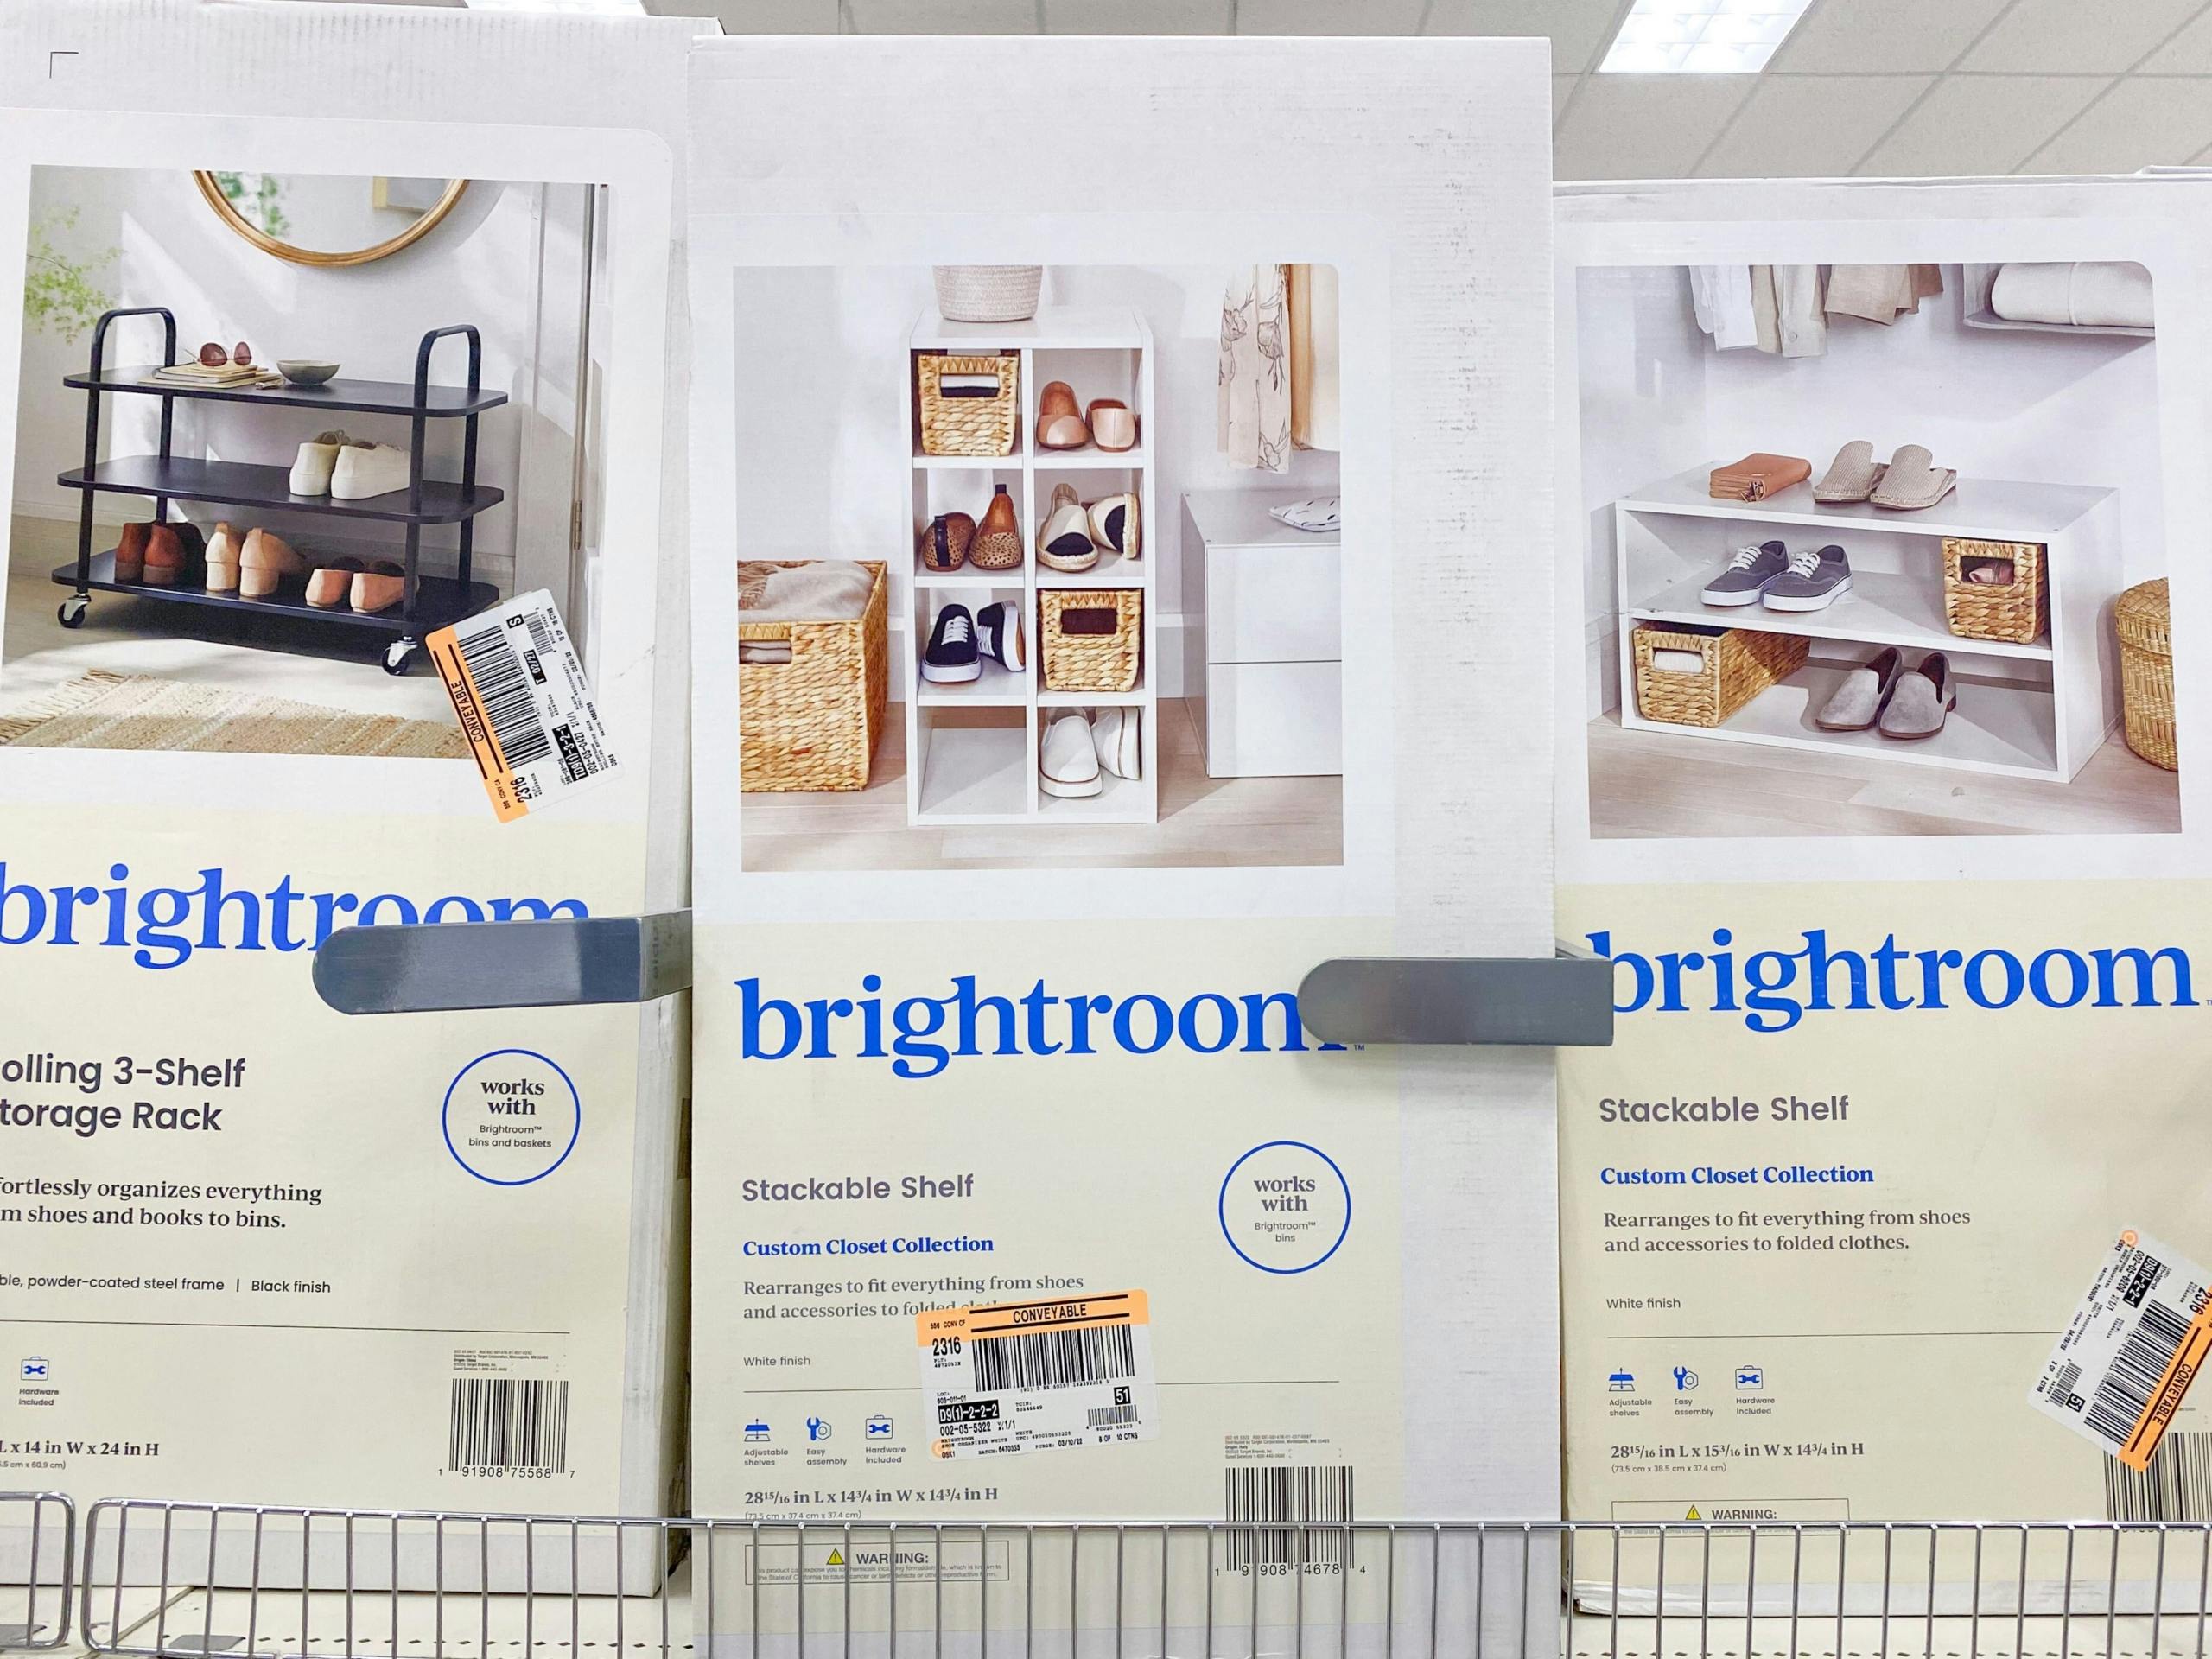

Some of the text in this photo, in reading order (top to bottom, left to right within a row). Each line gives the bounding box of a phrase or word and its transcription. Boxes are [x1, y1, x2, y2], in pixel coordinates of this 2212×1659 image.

[508, 616, 523, 627] S
[524, 652, 546, 685] T 02/27
[450, 681, 484, 742] CONVEYABLE
[573, 731, 599, 775] 002-05-0427
[509, 776, 533, 804] 2316
[2, 1053, 245, 1093] olling 3-Shelf
[480, 1077, 545, 1096] works
[486, 1096, 536, 1116] with
[1600, 1095, 1848, 1122] Stackable Shelf
[0, 1099, 222, 1137] torage Rack
[468, 1137, 552, 1148] bins and baskets
[1253, 1175, 1316, 1192] works
[1600, 1165, 1874, 1185] Custom Closet Collection
[0, 1177, 321, 1205] fortlessly organizes everything
[742, 1173, 974, 1201] Stackable Shelf
[1261, 1194, 1309, 1211] with
[27, 1205, 286, 1229] shoes and books to bins.
[1604, 1209, 1971, 1231] Rearranges to fit everything from shoes
[742, 1236, 995, 1256] Custom Closet Collection
[1274, 1233, 1296, 1243] bins
[1605, 1234, 1910, 1252] and accessories to folded clothes.
[2115, 1249, 2145, 1294] 002-05-6209
[27, 1274, 331, 1294] powder-coated steel frame Black finish
[744, 1274, 1084, 1297] Rearranges to fit everything from shoes
[2124, 1257, 2158, 1306] D9(1)-2-2-1
[743, 1304, 777, 1319] and
[780, 1302, 877, 1319] accessories
[880, 1303, 899, 1316] to
[1605, 1297, 1681, 1309] White finish
[2189, 1287, 2212, 1316] 2316
[1013, 1303, 1087, 1323] CONVEYABLE
[931, 1335, 962, 1357] 2316
[743, 1355, 811, 1367] White finish
[1115, 1387, 1130, 1404] 51
[1609, 1398, 1653, 1408] Adjustable
[1674, 1398, 1694, 1407] Easy
[2067, 1395, 2084, 1412] 51
[2152, 1363, 2193, 1426] CONVEYABLE
[939, 1403, 998, 1422] D9(1)-2-2-2
[1674, 1408, 1714, 1417] assembly
[1736, 1407, 1772, 1415] included
[938, 1420, 993, 1438] 002-05-5322
[10, 1443, 21, 1453] x
[24, 1440, 41, 1454] 14
[45, 1440, 62, 1454] in
[66, 1441, 84, 1454] W
[86, 1445, 97, 1455] x
[99, 1442, 120, 1456] 24
[124, 1441, 141, 1456] in
[145, 1443, 160, 1456] H
[743, 1448, 789, 1459] Adjustable
[806, 1448, 826, 1457] Easy
[865, 1446, 906, 1454] Hardware
[1658, 1442, 1864, 1458] in L x in W x in H
[806, 1457, 848, 1466] assembly
[461, 1468, 552, 1479] 91908 75568
[793, 1487, 998, 1503] in L x in W x in H
[1712, 1510, 1777, 1519] WARNING:
[1242, 1566, 1287, 1576] 9908
